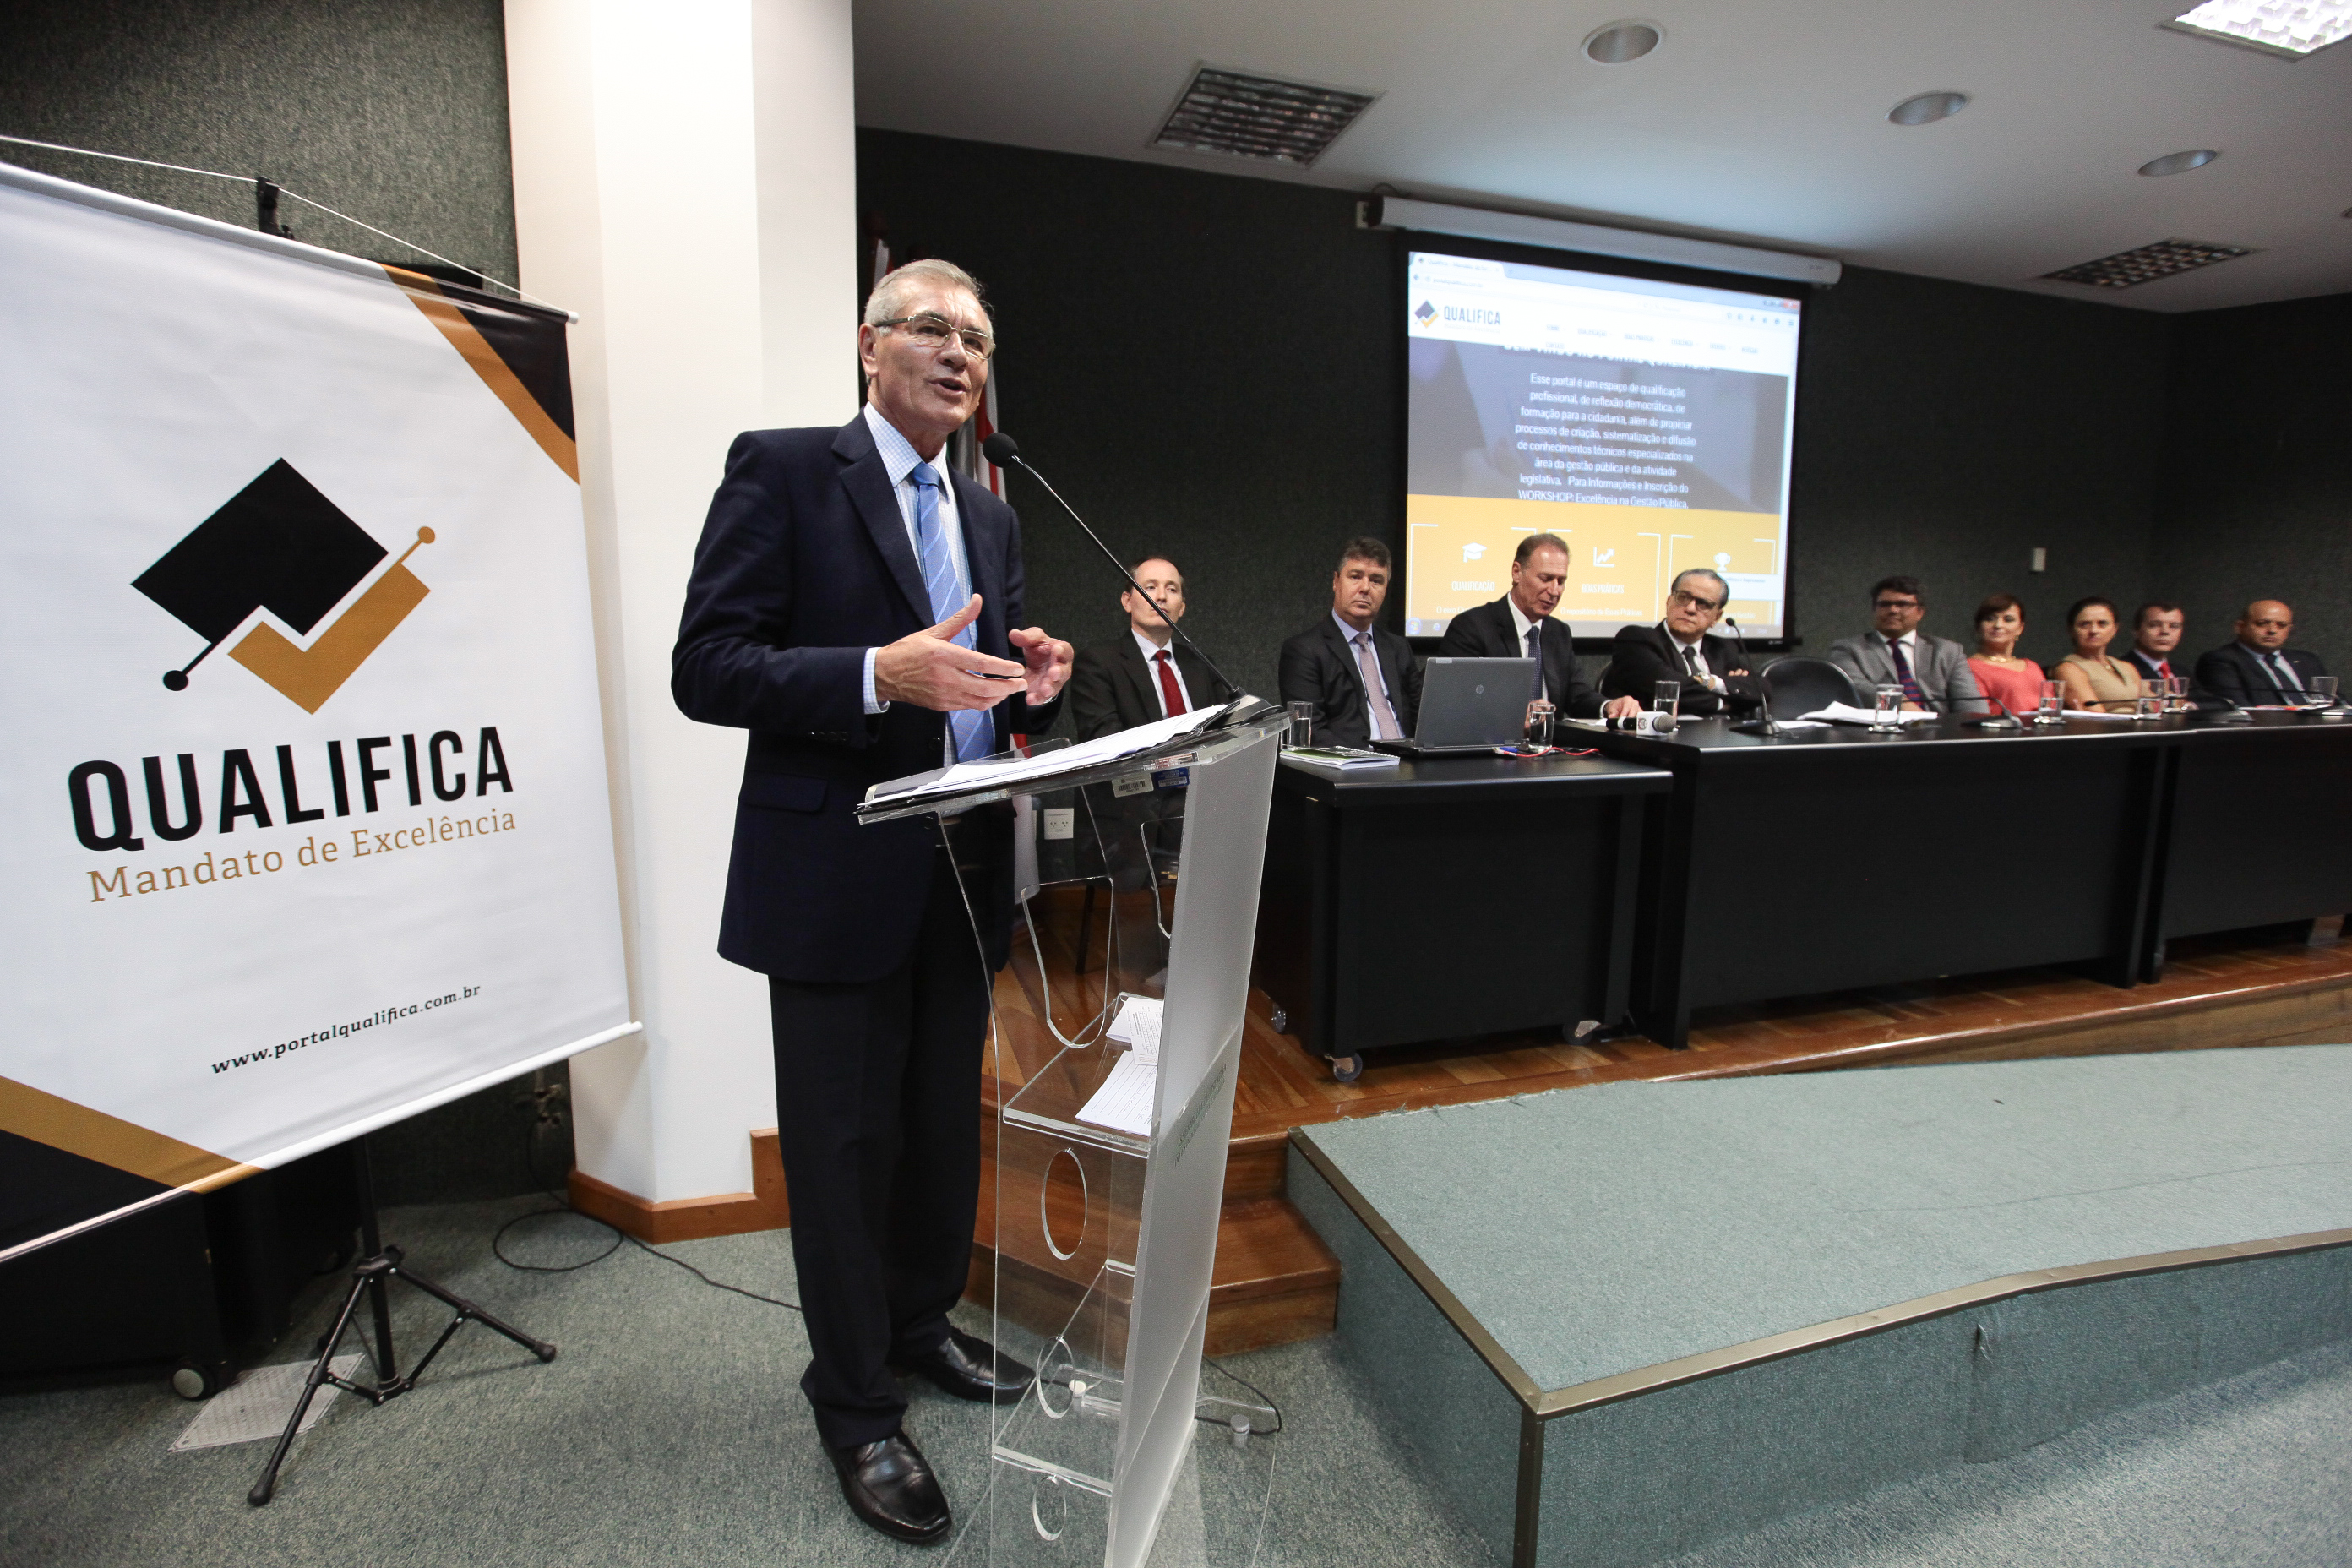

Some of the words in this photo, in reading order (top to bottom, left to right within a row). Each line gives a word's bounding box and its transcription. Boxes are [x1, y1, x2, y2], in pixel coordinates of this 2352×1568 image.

[1444, 305, 1500, 325] QUALIFICA
[1529, 373, 1550, 384] Esse
[1551, 377, 1576, 387] portal
[1576, 378, 1582, 388] é
[1583, 380, 1598, 389] um
[1598, 381, 1627, 394] espaço
[1628, 383, 1639, 394] de
[1640, 384, 1686, 398] qualificação
[1529, 390, 1578, 405] profissional,
[1579, 395, 1590, 406] de
[1592, 395, 1623, 408] reflexão
[1625, 399, 1674, 413] democrática,
[1674, 403, 1685, 414] de
[1520, 406, 1560, 420] formação
[1560, 411, 1579, 421] para
[1587, 411, 1627, 425] cidadania,
[1628, 416, 1647, 427] além
[1648, 416, 1658, 427] de
[1659, 418, 1692, 431] propiciar
[1515, 424, 1557, 436] processos
[1558, 426, 1569, 437] de
[1571, 427, 1601, 439] criação,
[1602, 429, 1660, 444] sistematização
[1661, 436, 1667, 444] e
[1668, 434, 1696, 446] difusão
[1516, 439, 1527, 450] de
[1529, 441, 1592, 455] conhecimentos
[1592, 444, 1626, 457] técnicos
[1627, 449, 1682, 461] especializados
[1683, 453, 1694, 463] na
[1534, 457, 1553, 468] área
[1554, 459, 1565, 470] da
[1565, 460, 1593, 472] gestão
[1594, 461, 1623, 473] pública
[1625, 465, 1630, 474] e
[1631, 464, 1642, 475] da
[1642, 466, 1677, 477] atividade
[1567, 476, 1587, 487] Para
[1587, 476, 1636, 491] Informações
[1636, 482, 1642, 490] e
[1643, 480, 1678, 493] Inscrição
[1679, 482, 1689, 494] do
[1518, 489, 1574, 502] WORKSHOP:
[1576, 492, 1618, 505] Excelência
[1619, 496, 1629, 506] na
[1630, 495, 1658, 507] Gestão
[1451, 580, 1495, 592] QUALIFICAÇÃO
[1581, 583, 1598, 593] BOAS
[1598, 582, 1625, 594] PRÁTICAS
[1436, 606, 1442, 614] O
[68, 726, 514, 853] QUALIFICA
[86, 849, 285, 903] Mandato
[297, 837, 339, 868] de
[351, 808, 518, 858] Excelência
[211, 986, 481, 1074] www.portalqualifica.com.br
